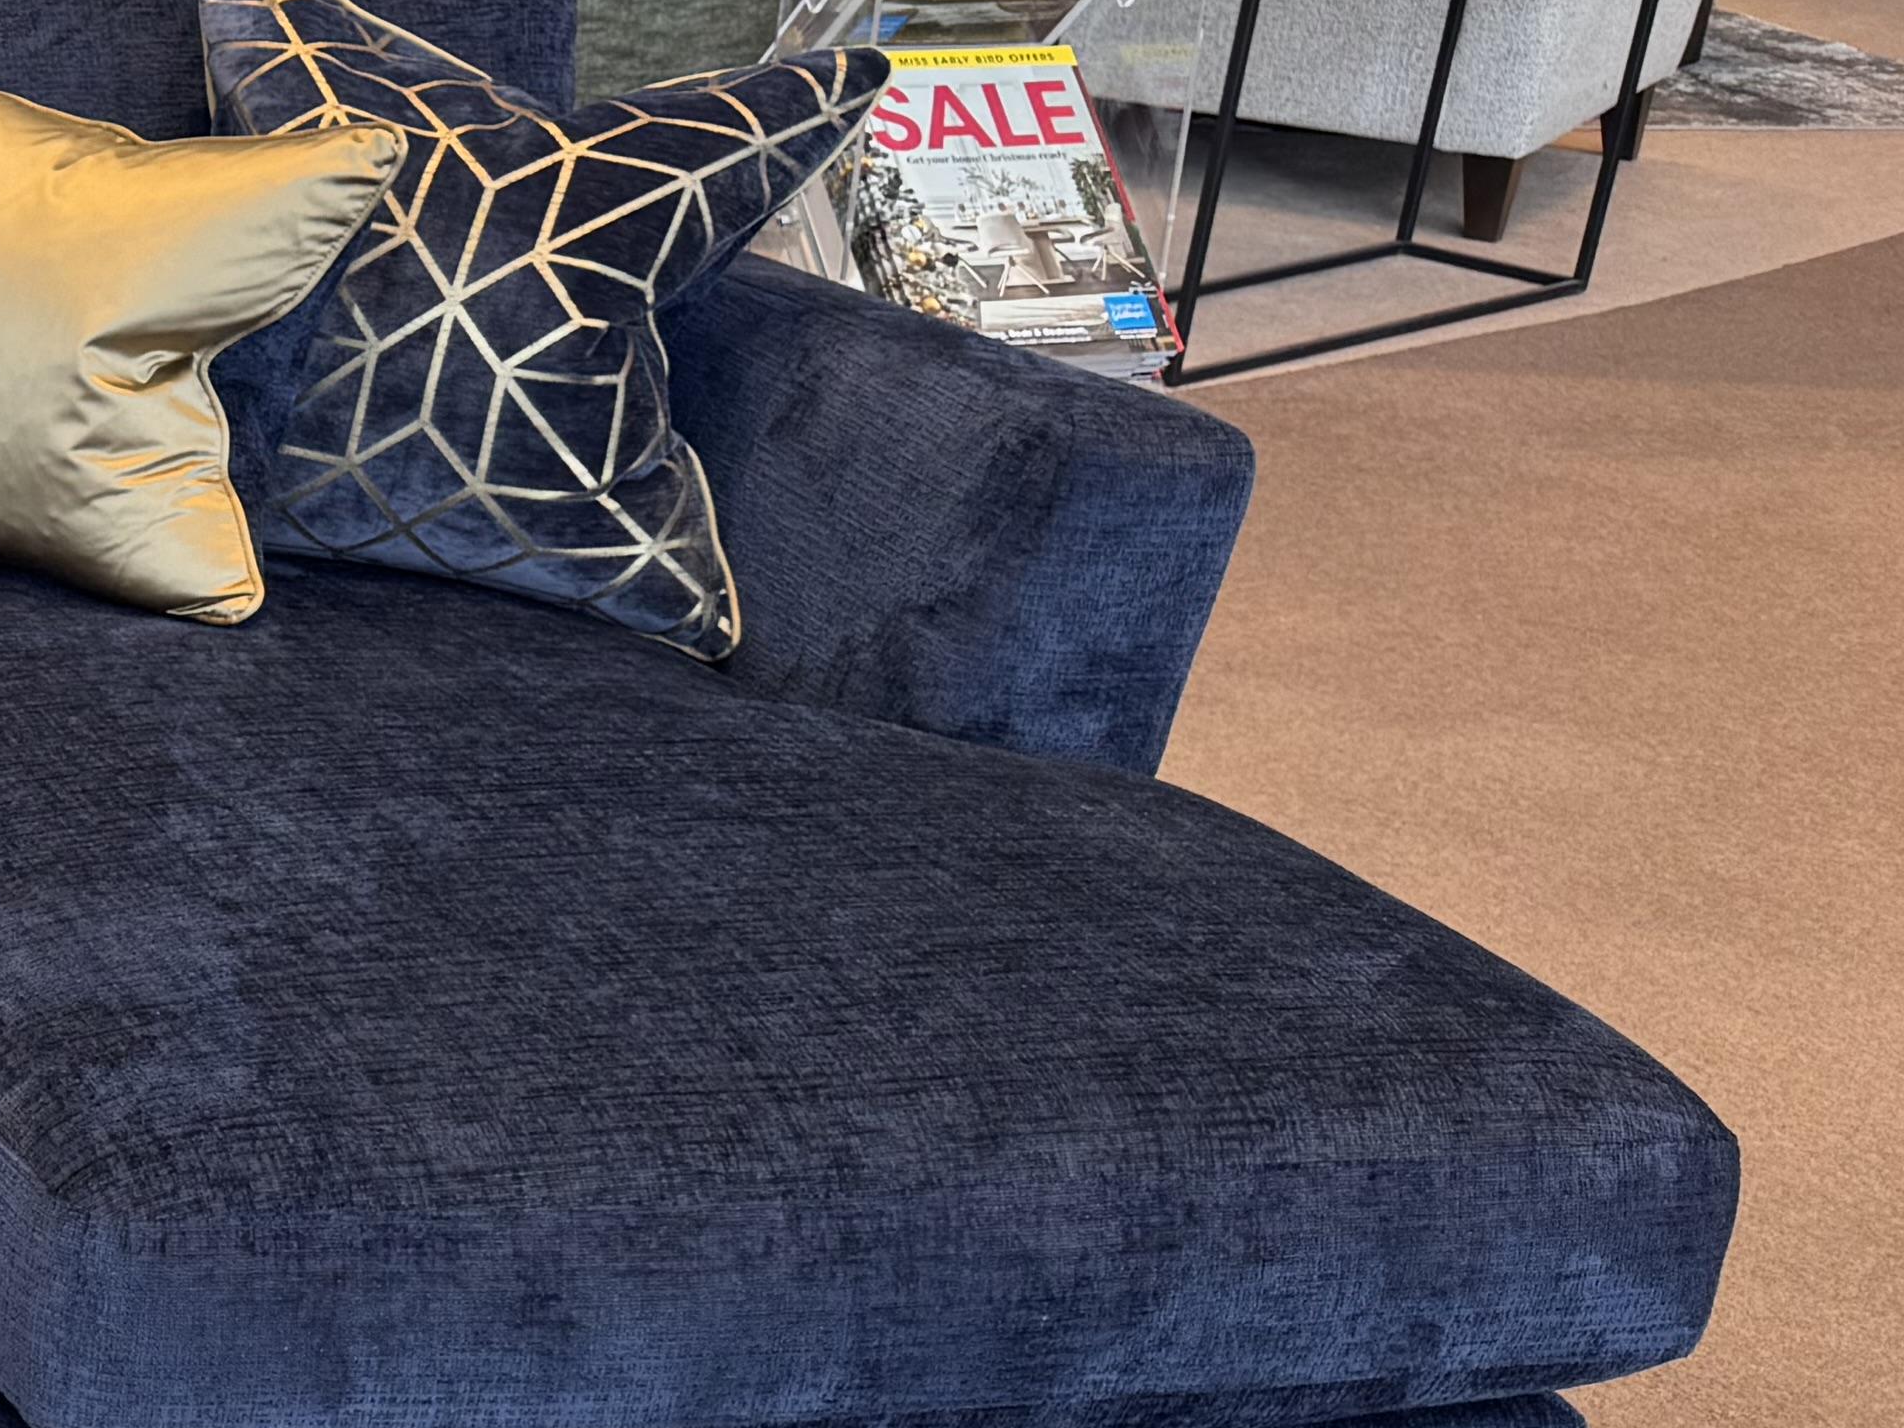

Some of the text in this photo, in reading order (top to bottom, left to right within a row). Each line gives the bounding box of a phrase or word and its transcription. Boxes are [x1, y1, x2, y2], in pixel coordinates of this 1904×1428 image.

[898, 52, 1056, 67] MISS EARLY BIRD OFFERS
[872, 80, 1086, 151] SALE
